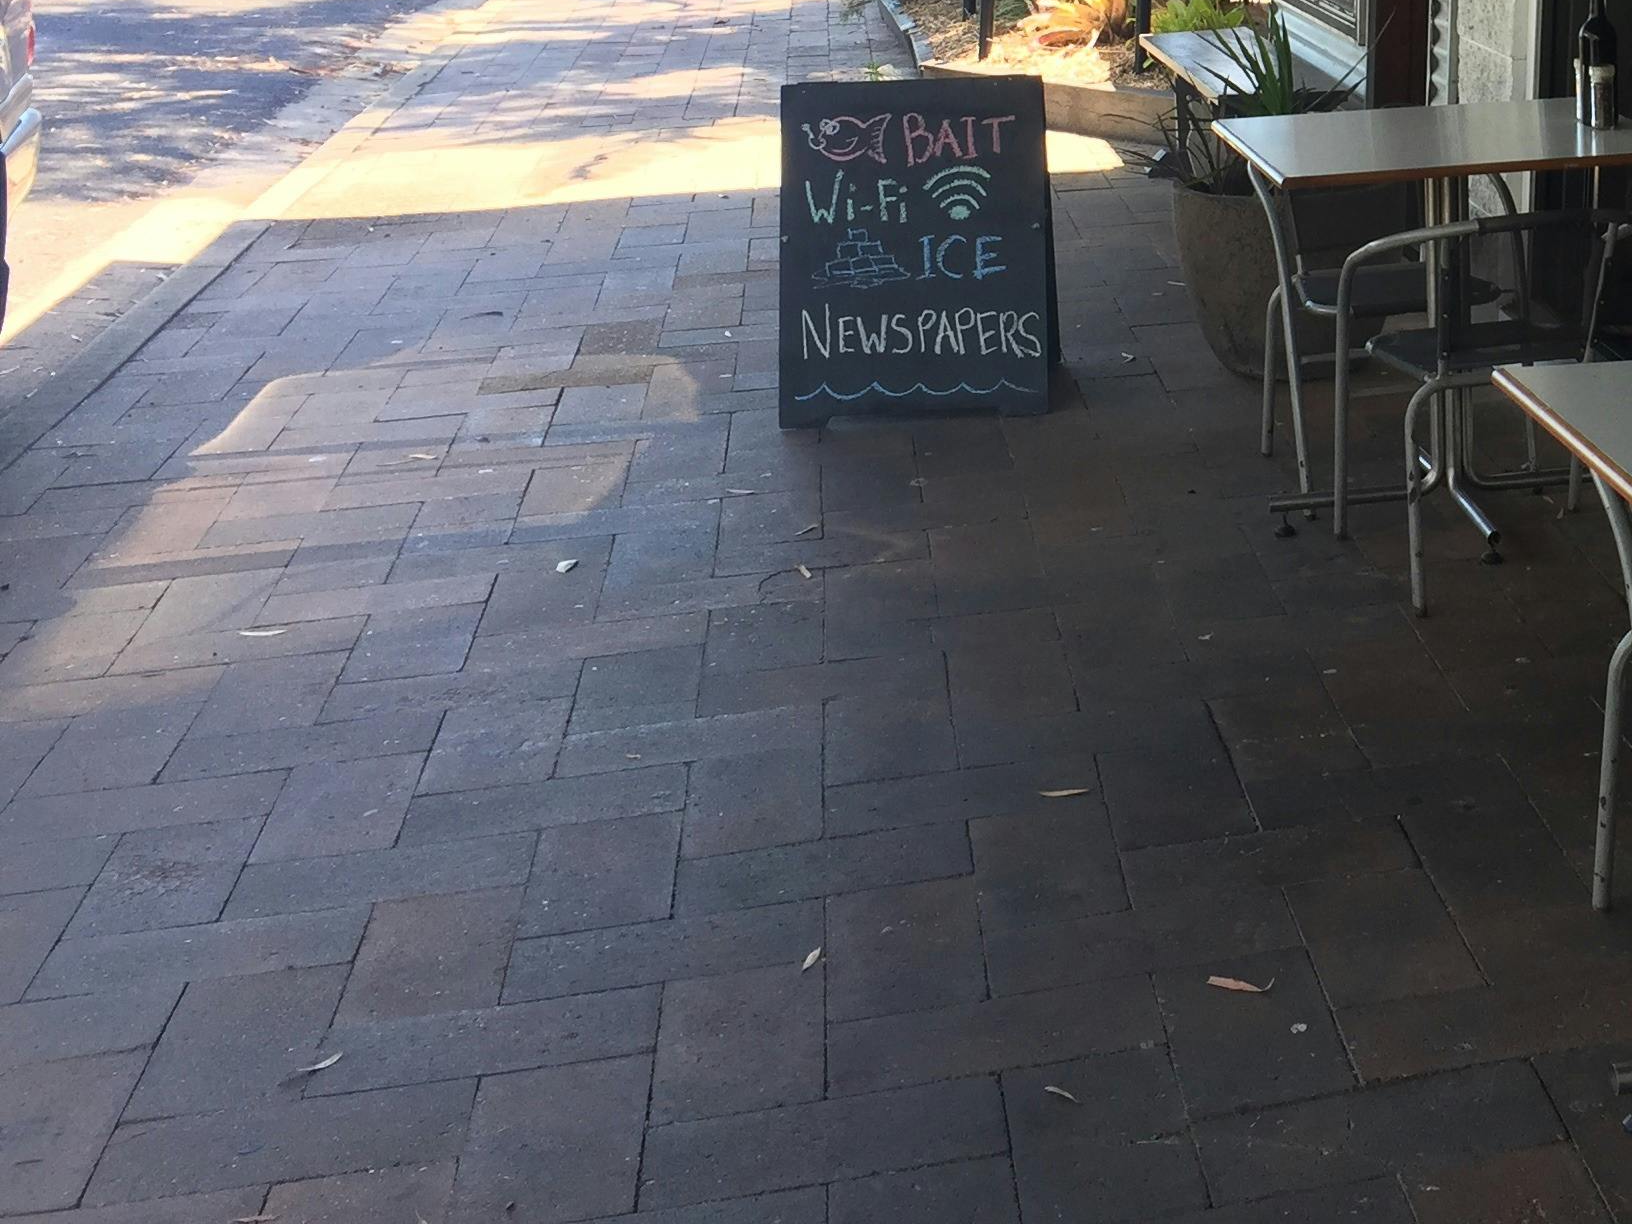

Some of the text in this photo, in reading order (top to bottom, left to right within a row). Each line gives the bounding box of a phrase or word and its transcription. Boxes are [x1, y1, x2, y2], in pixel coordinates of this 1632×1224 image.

[902, 112, 1016, 167] BAIT
[806, 169, 908, 224] Wi-Fi
[916, 234, 1007, 280] ICE
[802, 303, 1042, 359] NEWSPAPERS
